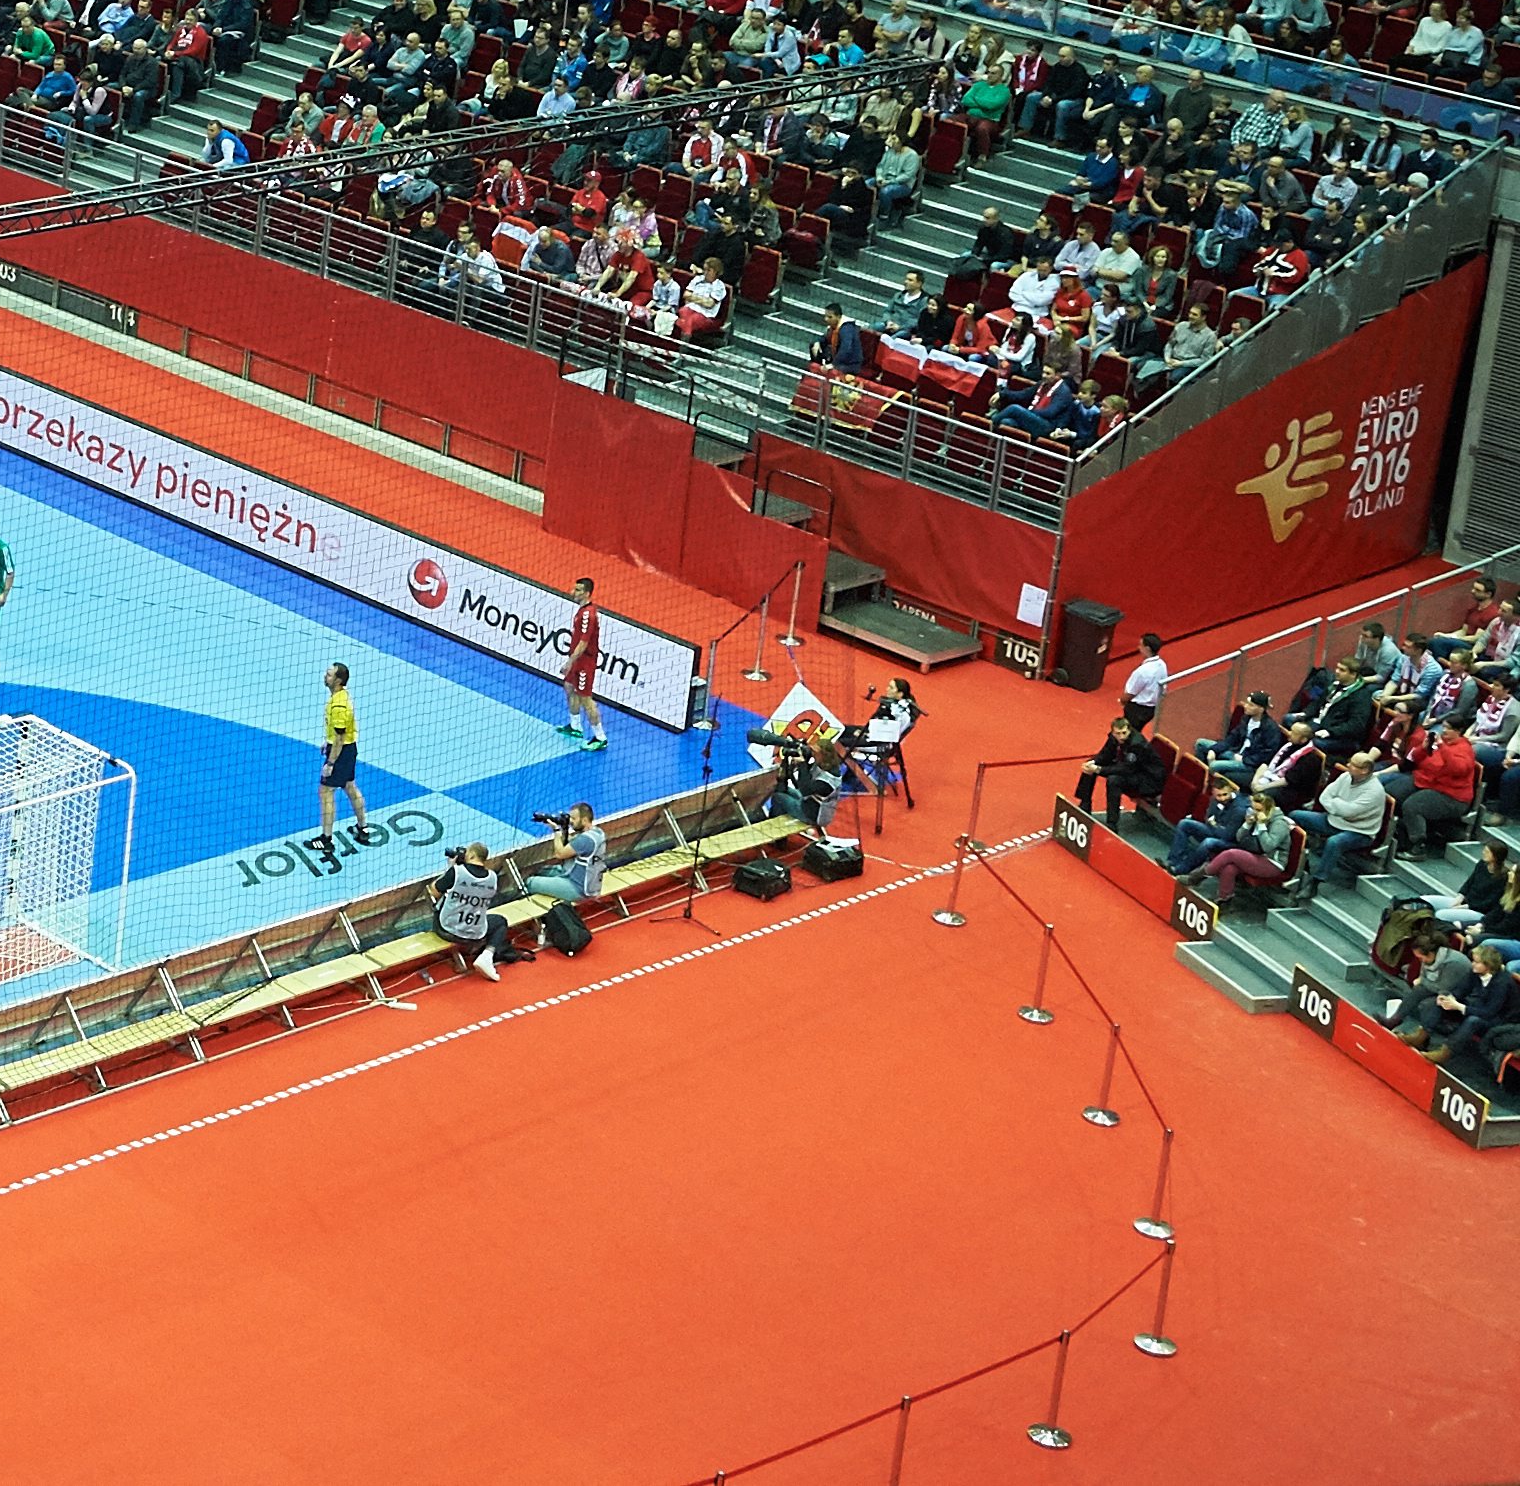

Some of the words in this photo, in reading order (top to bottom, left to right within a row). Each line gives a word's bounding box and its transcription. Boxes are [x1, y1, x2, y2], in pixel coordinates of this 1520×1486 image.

[1354, 406, 1420, 454] EURO
[1347, 442, 1411, 499] 2016
[1344, 485, 1405, 520] POLAND
[1002, 639, 1039, 669] 105
[1059, 811, 1089, 849] 106
[1176, 896, 1209, 936] 106
[1296, 984, 1332, 1026] 106
[1439, 1086, 1478, 1131] 106
